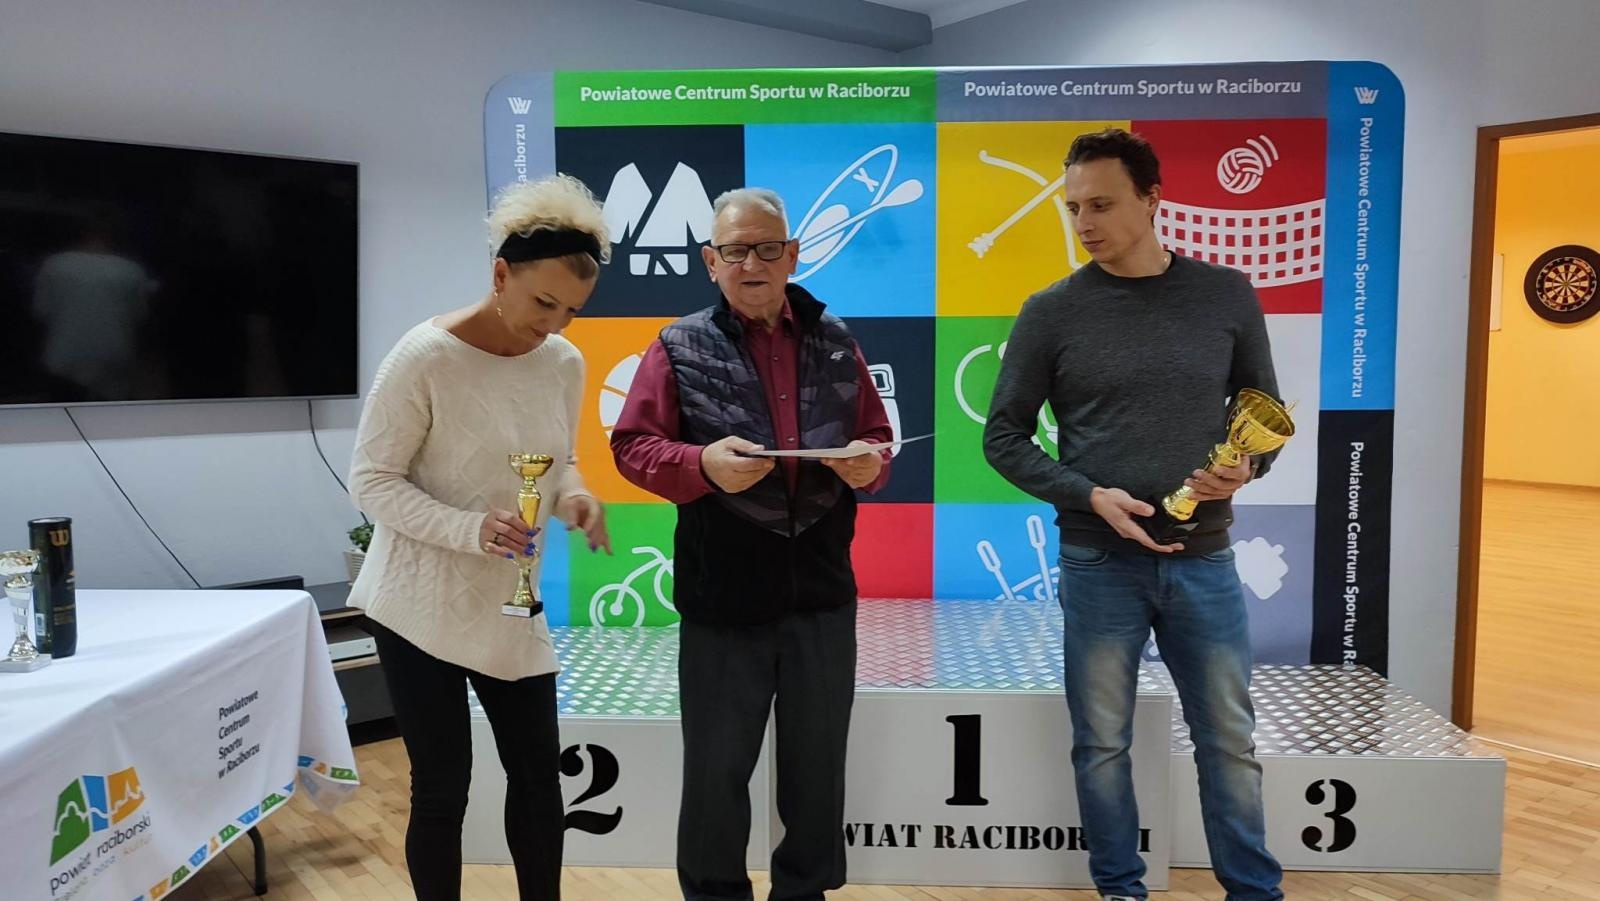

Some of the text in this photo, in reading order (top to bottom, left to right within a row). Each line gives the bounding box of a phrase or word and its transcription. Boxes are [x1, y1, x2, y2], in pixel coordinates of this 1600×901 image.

[580, 83, 910, 101] Powiatowe Centrum Sportu w Raciborzu
[964, 78, 1301, 97] Powiatowe Centrum Sportu w Raciborzu
[513, 123, 527, 185] aciborzu
[1352, 117, 1374, 398] Powiatowe Centrum Sportu w Raciborzu
[1348, 442, 1364, 520] Powiatowe
[1345, 522, 1361, 583] Centrum
[1343, 586, 1360, 632] Sportu
[1343, 634, 1354, 647] w
[218, 690, 258, 720] Powiatowe
[218, 714, 250, 740] Centrum
[218, 737, 243, 760] Sportu
[226, 744, 260, 774] Raciborzu
[945, 714, 989, 806] 1
[559, 743, 623, 835] 2
[1301, 779, 1357, 853] 3
[933, 825, 1152, 852] RACIBORI
